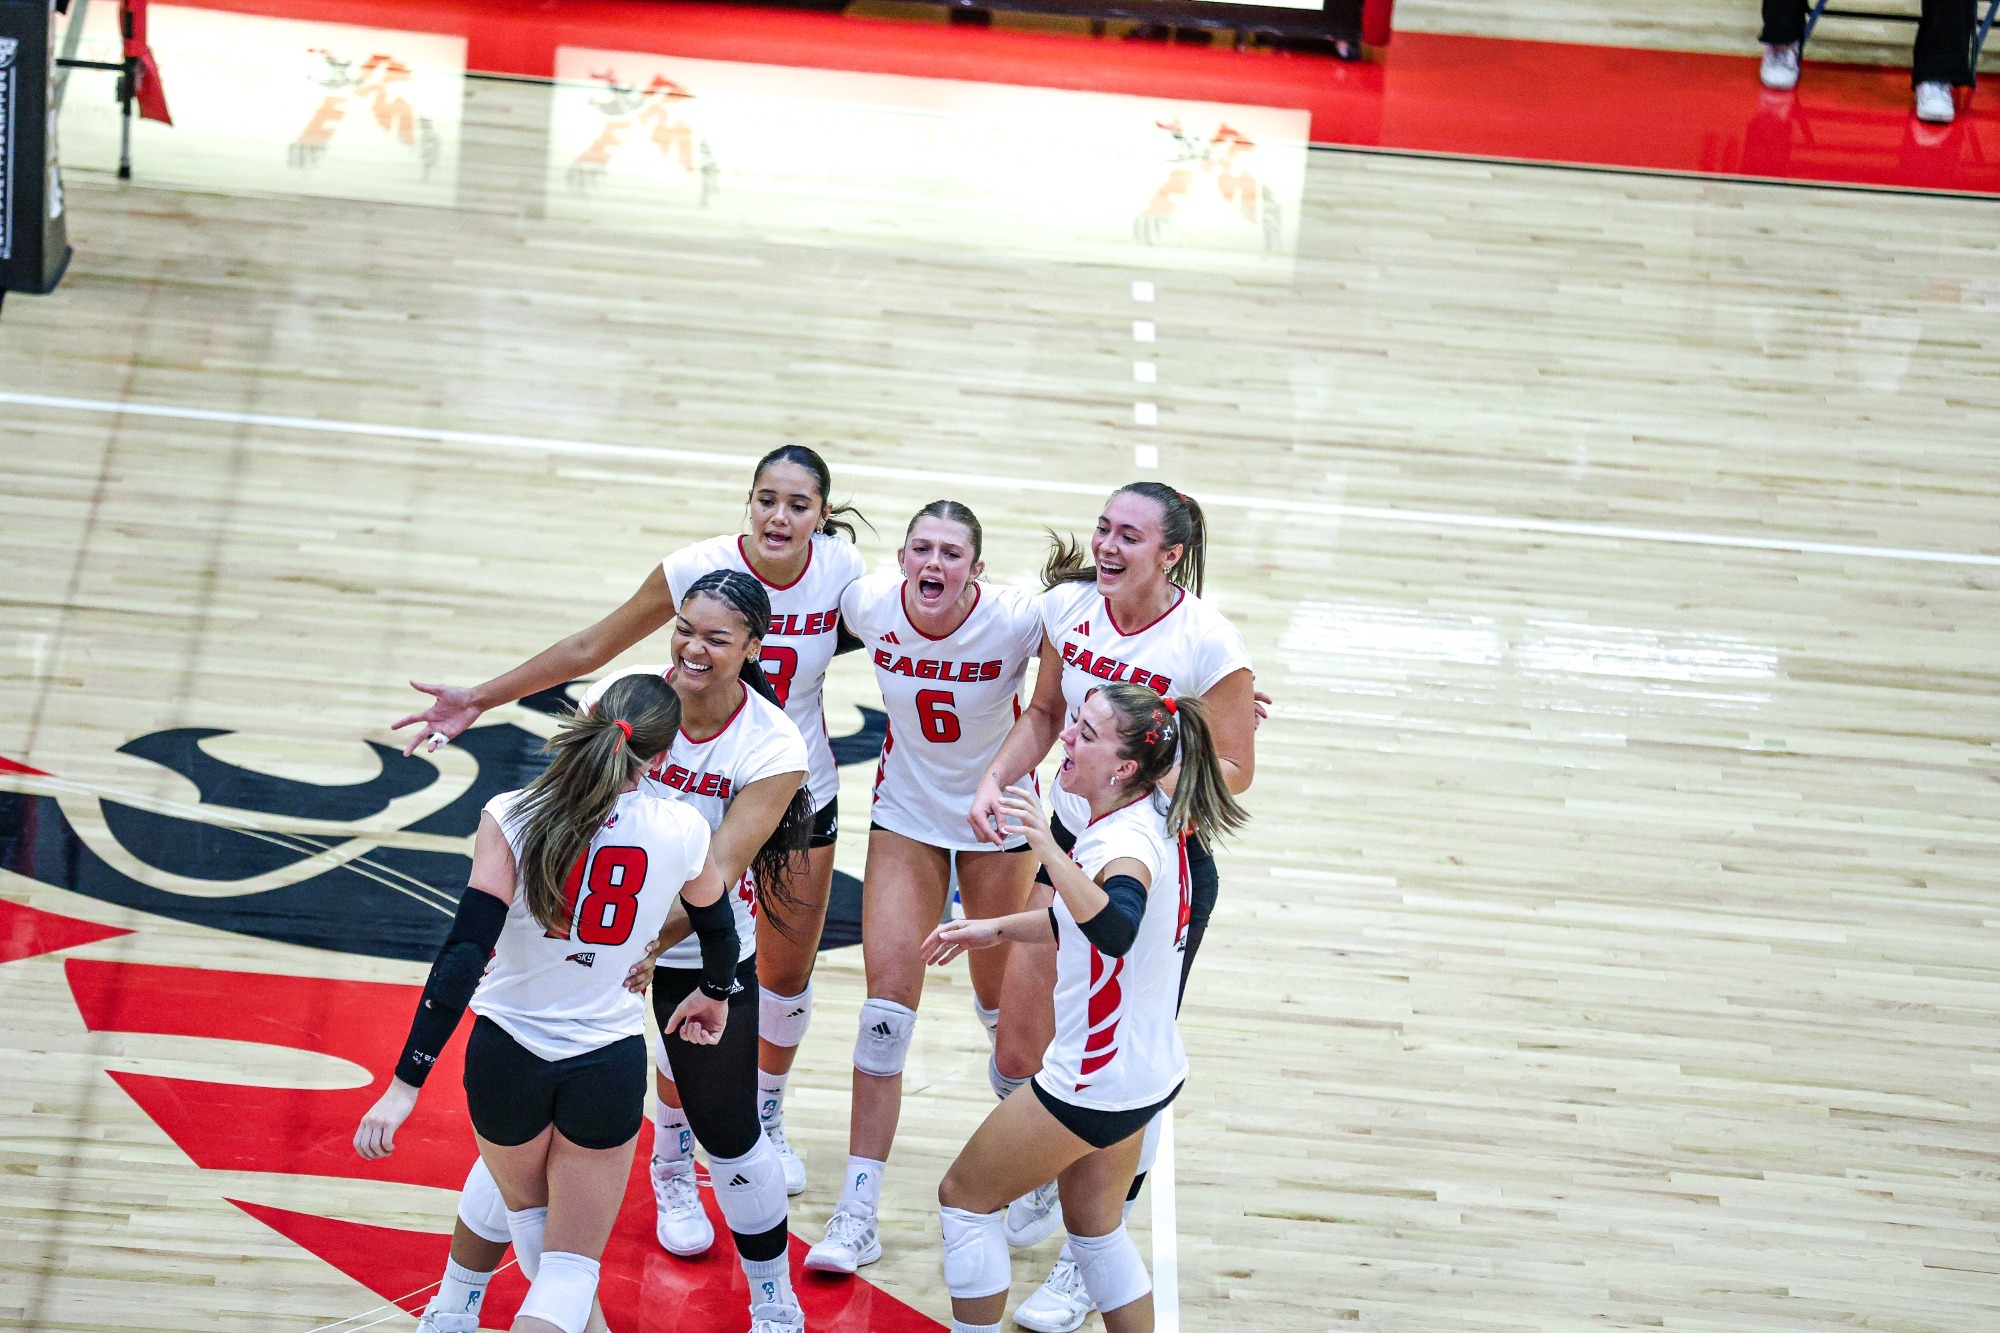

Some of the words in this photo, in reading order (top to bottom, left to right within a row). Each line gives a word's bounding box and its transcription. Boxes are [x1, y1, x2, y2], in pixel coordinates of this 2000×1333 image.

[767, 608, 838, 635] GLES
[874, 648, 1003, 682] EAGLES
[1061, 641, 1172, 697] EAGLES
[915, 689, 961, 743] 6
[577, 953, 594, 963] SKY
